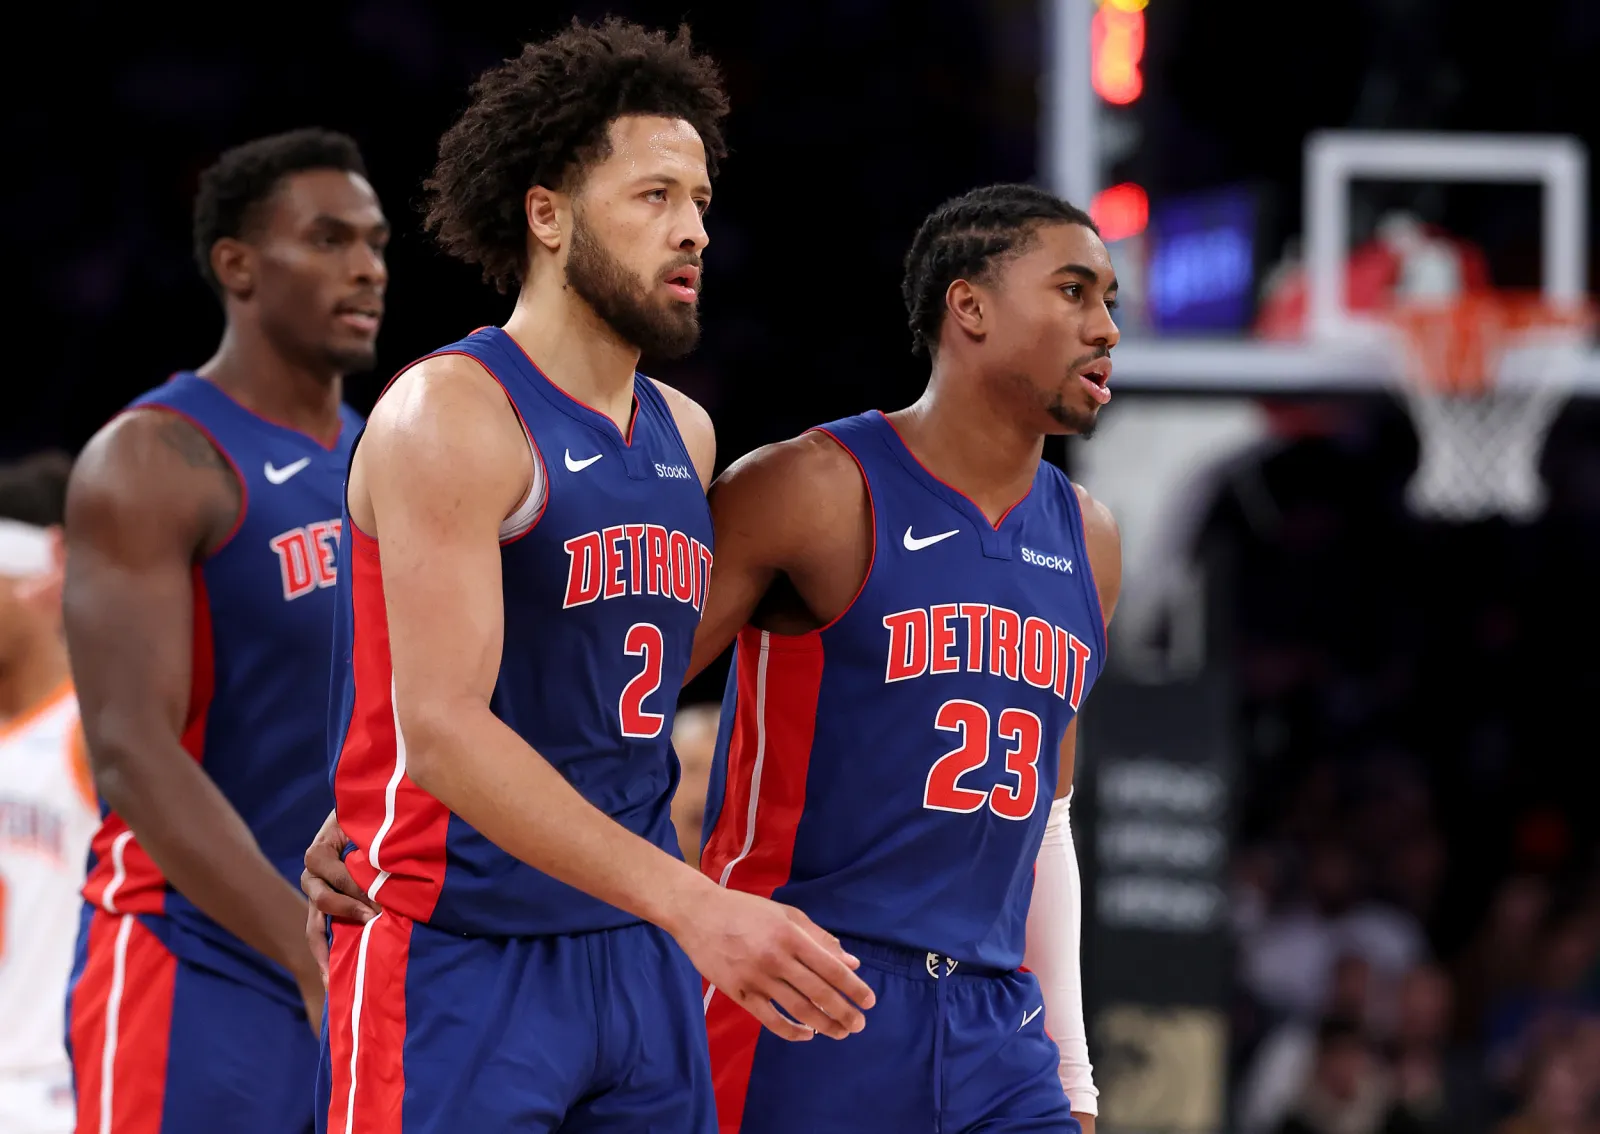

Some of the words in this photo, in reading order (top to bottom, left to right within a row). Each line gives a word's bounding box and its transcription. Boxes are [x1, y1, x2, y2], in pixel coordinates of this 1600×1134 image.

[655, 462, 692, 480] StockX
[563, 523, 714, 622] DETROIT
[1021, 547, 1073, 575] StockX
[618, 622, 665, 739] 2
[883, 602, 1091, 713] DETROIT
[923, 698, 1043, 821] 23
